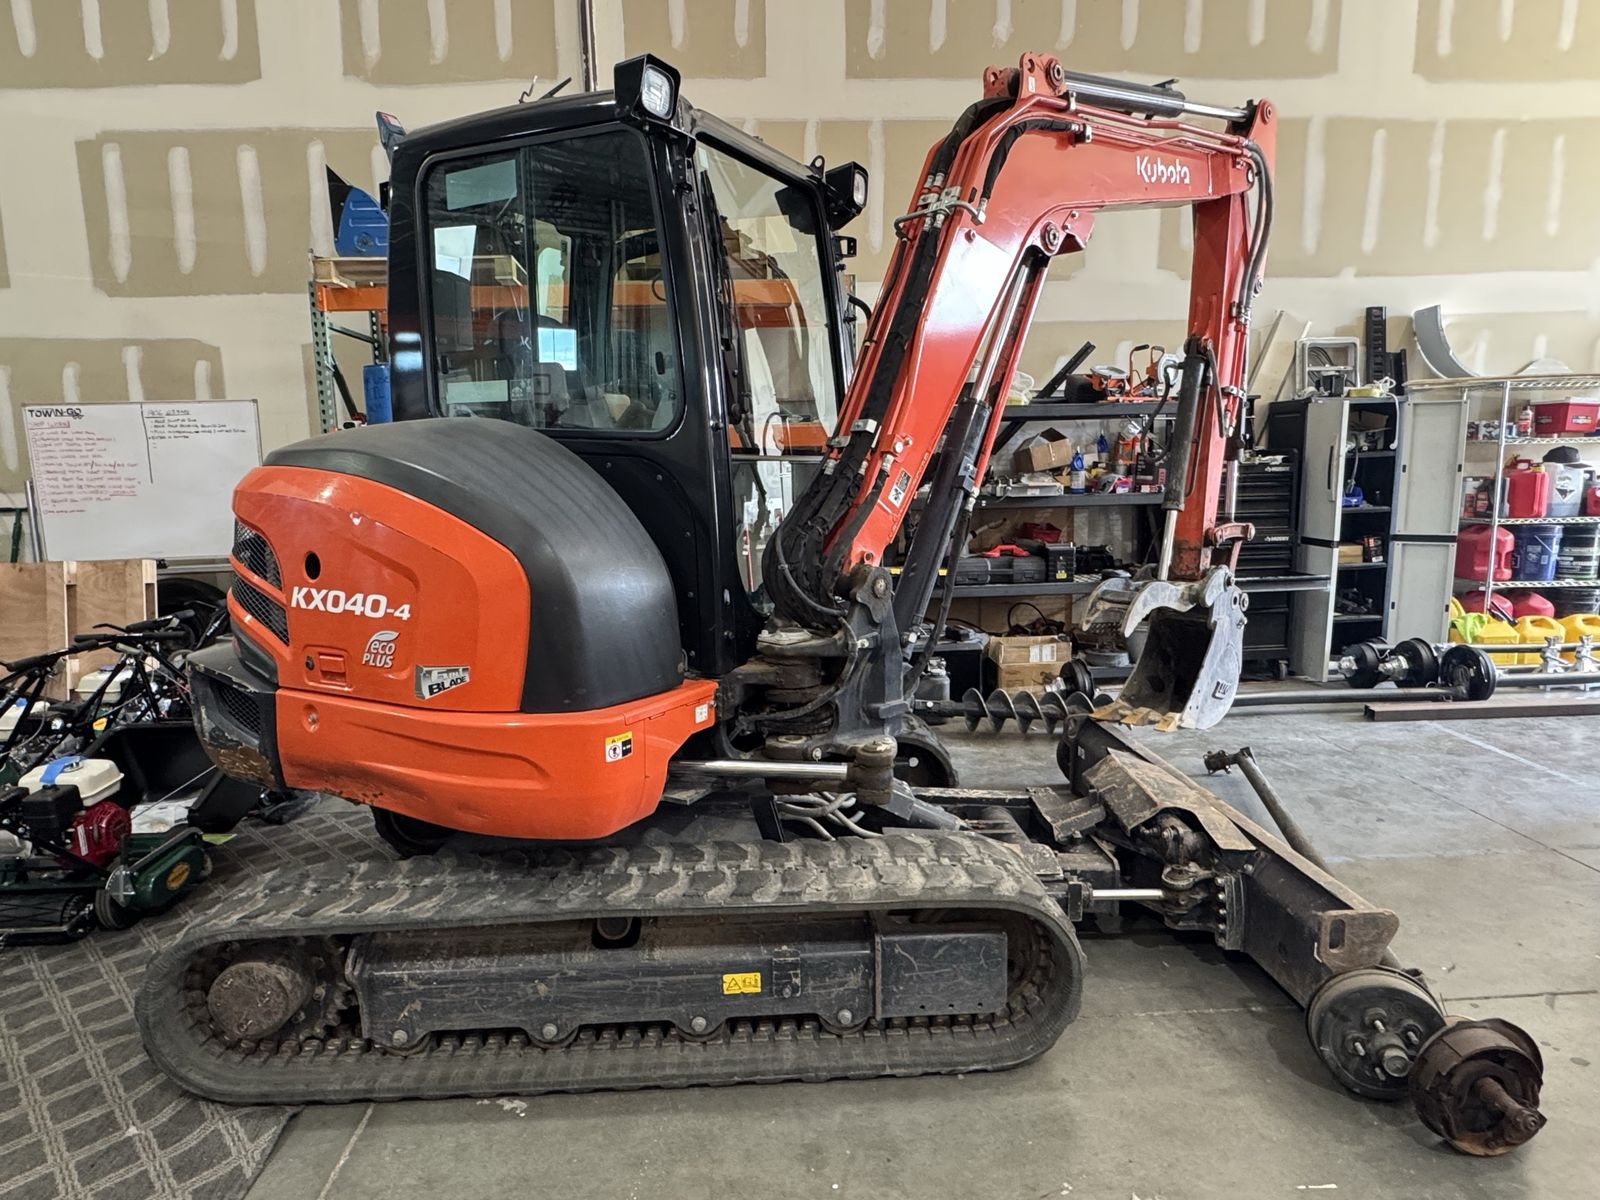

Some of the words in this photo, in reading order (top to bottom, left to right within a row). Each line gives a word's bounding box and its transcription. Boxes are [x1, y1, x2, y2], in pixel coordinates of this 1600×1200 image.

[1136, 155, 1191, 184] Kubota
[291, 586, 411, 621] KX040-4
[370, 640, 396, 655] eco
[362, 653, 394, 668] PLUS
[428, 676, 467, 696] BLADE
